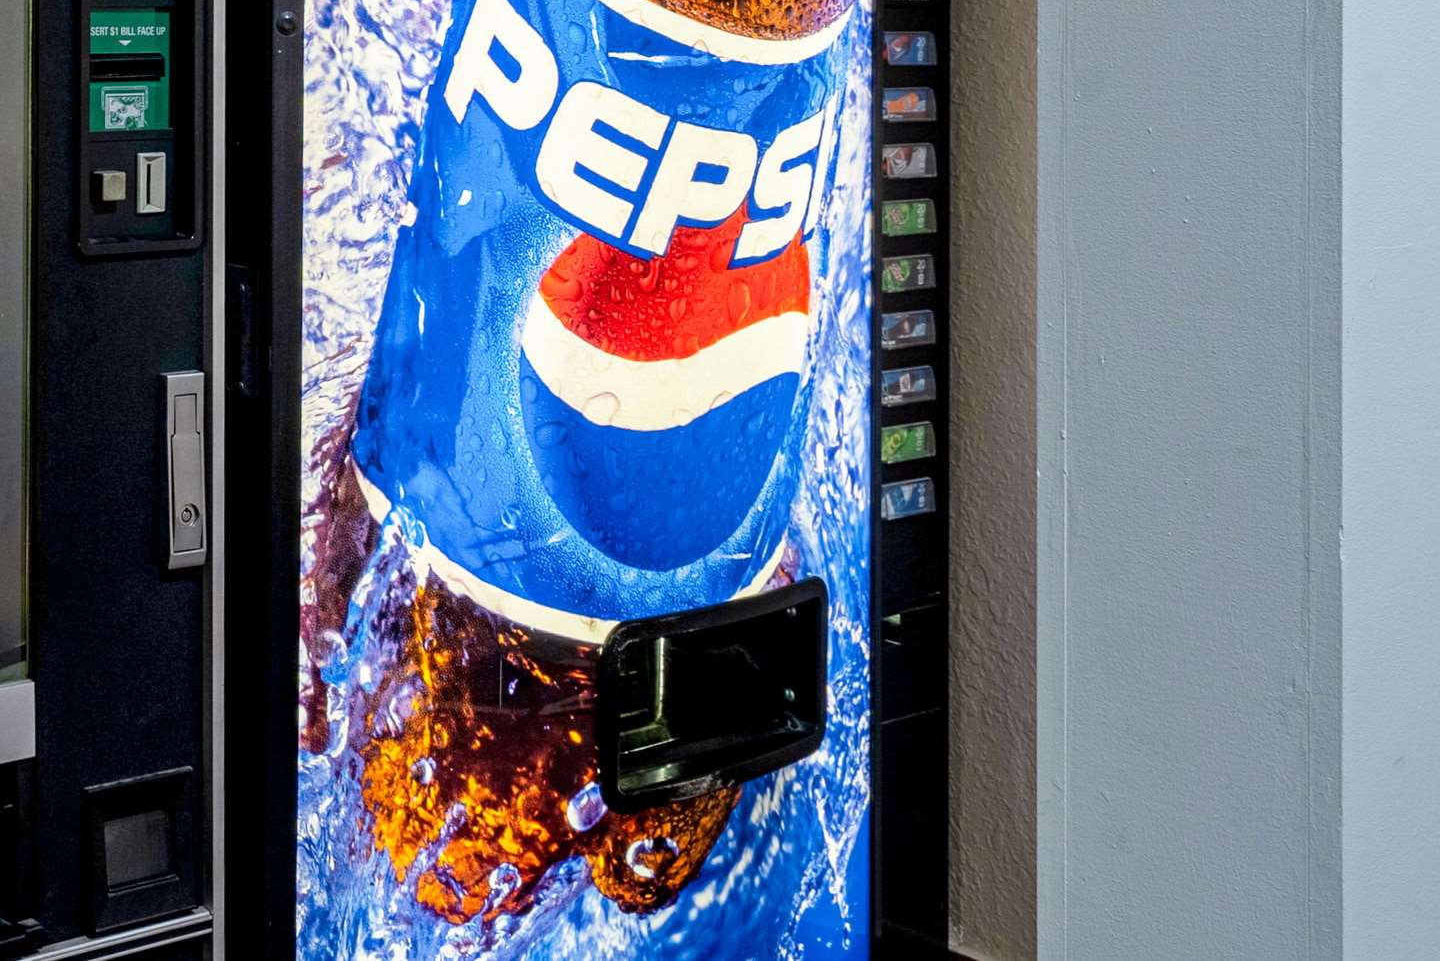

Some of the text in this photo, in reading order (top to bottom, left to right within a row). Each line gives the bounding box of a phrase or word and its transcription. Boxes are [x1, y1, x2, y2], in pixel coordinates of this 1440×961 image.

[120, 26, 136, 36] BILL
[136, 25, 155, 36] FACE
[155, 26, 166, 36] UP
